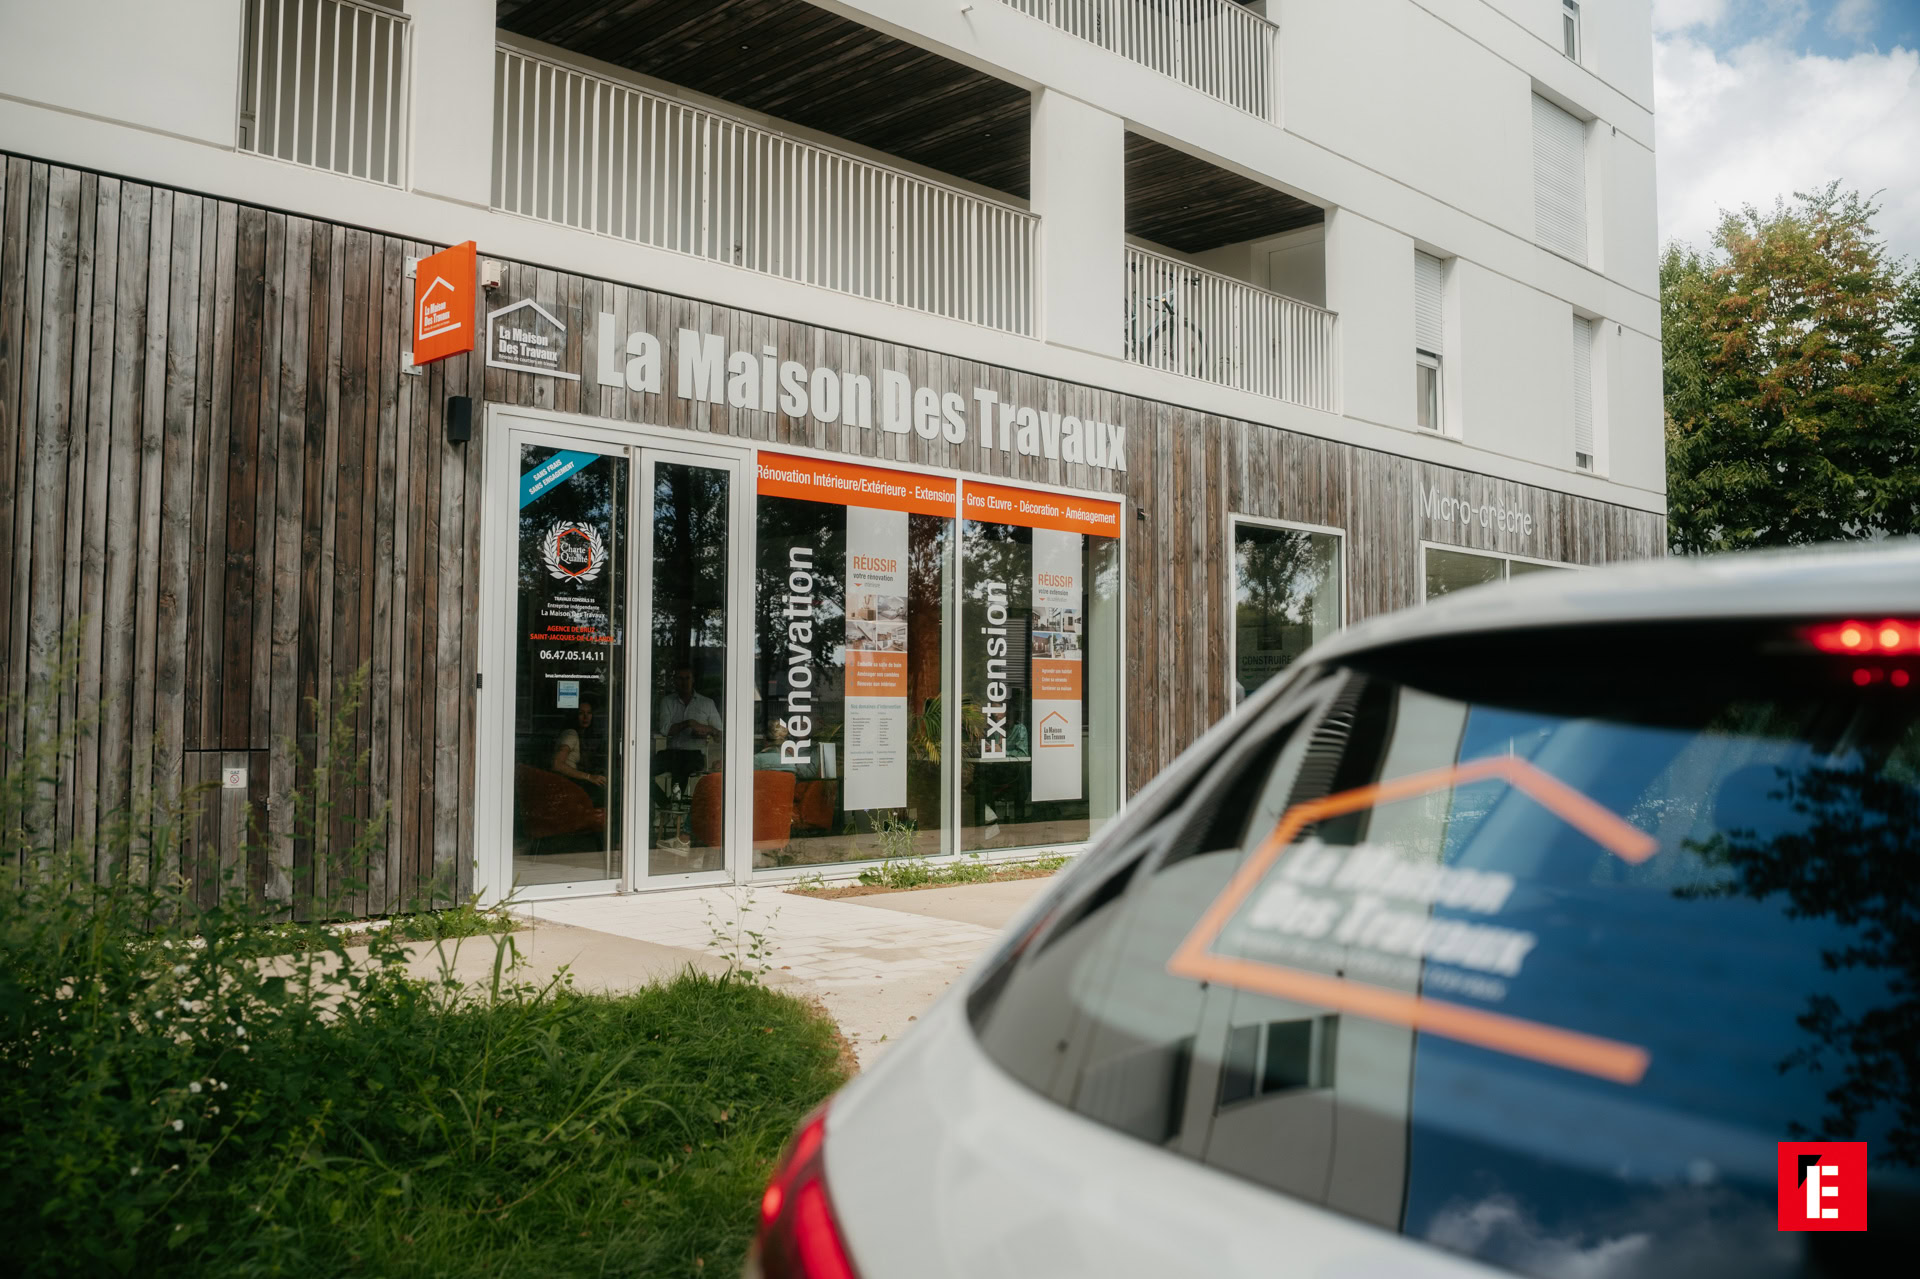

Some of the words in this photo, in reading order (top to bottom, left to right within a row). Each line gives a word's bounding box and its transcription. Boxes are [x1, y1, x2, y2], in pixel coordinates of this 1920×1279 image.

[430, 302, 446, 314] Maison
[433, 311, 450, 323] Travaux
[500, 326, 510, 340] La
[512, 328, 548, 346] Maison
[499, 340, 518, 354] Des
[520, 342, 558, 361] Travaux
[597, 312, 661, 394] La
[678, 328, 872, 430] Maison
[883, 368, 966, 444] Des
[974, 387, 1127, 472] Travaux
[529, 482, 543, 495] SANS
[542, 461, 574, 486] ENGAGEMENT
[533, 468, 548, 481] SANS
[547, 459, 562, 472] FRAIS
[756, 465, 811, 485] Rénovation
[813, 472, 906, 497] Intérieure/Extérieure
[915, 486, 956, 504] Extension
[967, 493, 985, 508] Gros
[987, 496, 1012, 511] Œuvre
[1020, 500, 1059, 517] Décoration
[1065, 508, 1116, 525] Aménagement
[1420, 481, 1532, 536] Micro-crèche
[561, 542, 586, 553] Charte
[561, 552, 588, 564] Qualité
[853, 554, 897, 573] RÉUSSIR
[1038, 572, 1073, 588] RÉUSSIR
[540, 650, 604, 660] 06.47.05.14.11
[780, 546, 814, 765] Rénovation
[1242, 655, 1292, 665] CONSTRUIRE
[981, 582, 1007, 760] Extension
